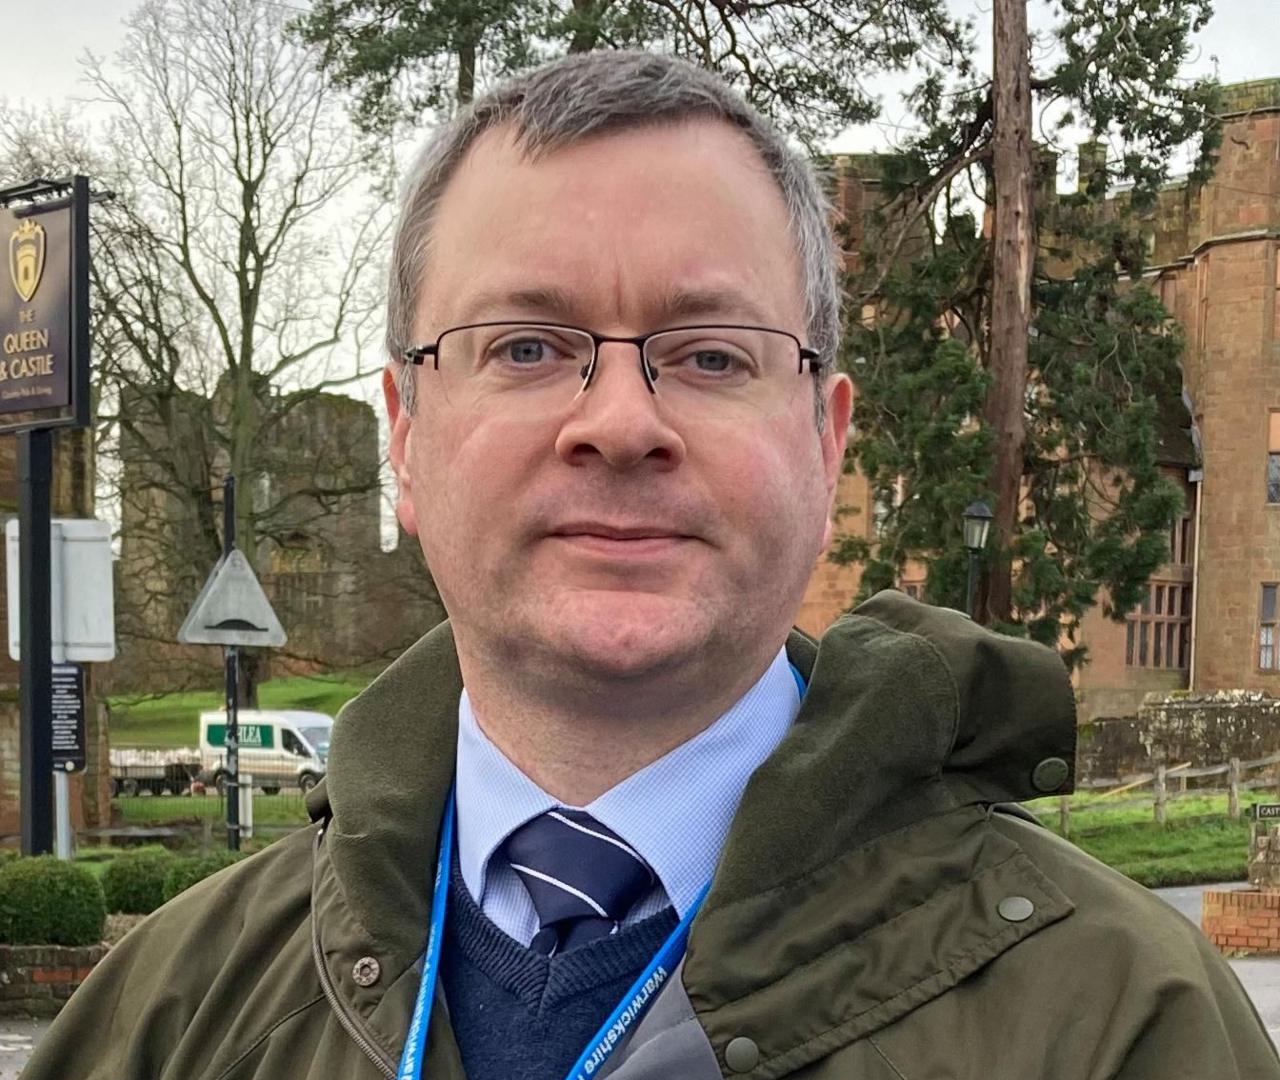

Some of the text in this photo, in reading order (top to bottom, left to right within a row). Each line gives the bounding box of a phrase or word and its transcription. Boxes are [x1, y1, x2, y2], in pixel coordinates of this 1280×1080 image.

[3, 328, 49, 354] QUEEN
[10, 354, 54, 378] CASTLE
[584, 966, 668, 1074] Warwickshire
